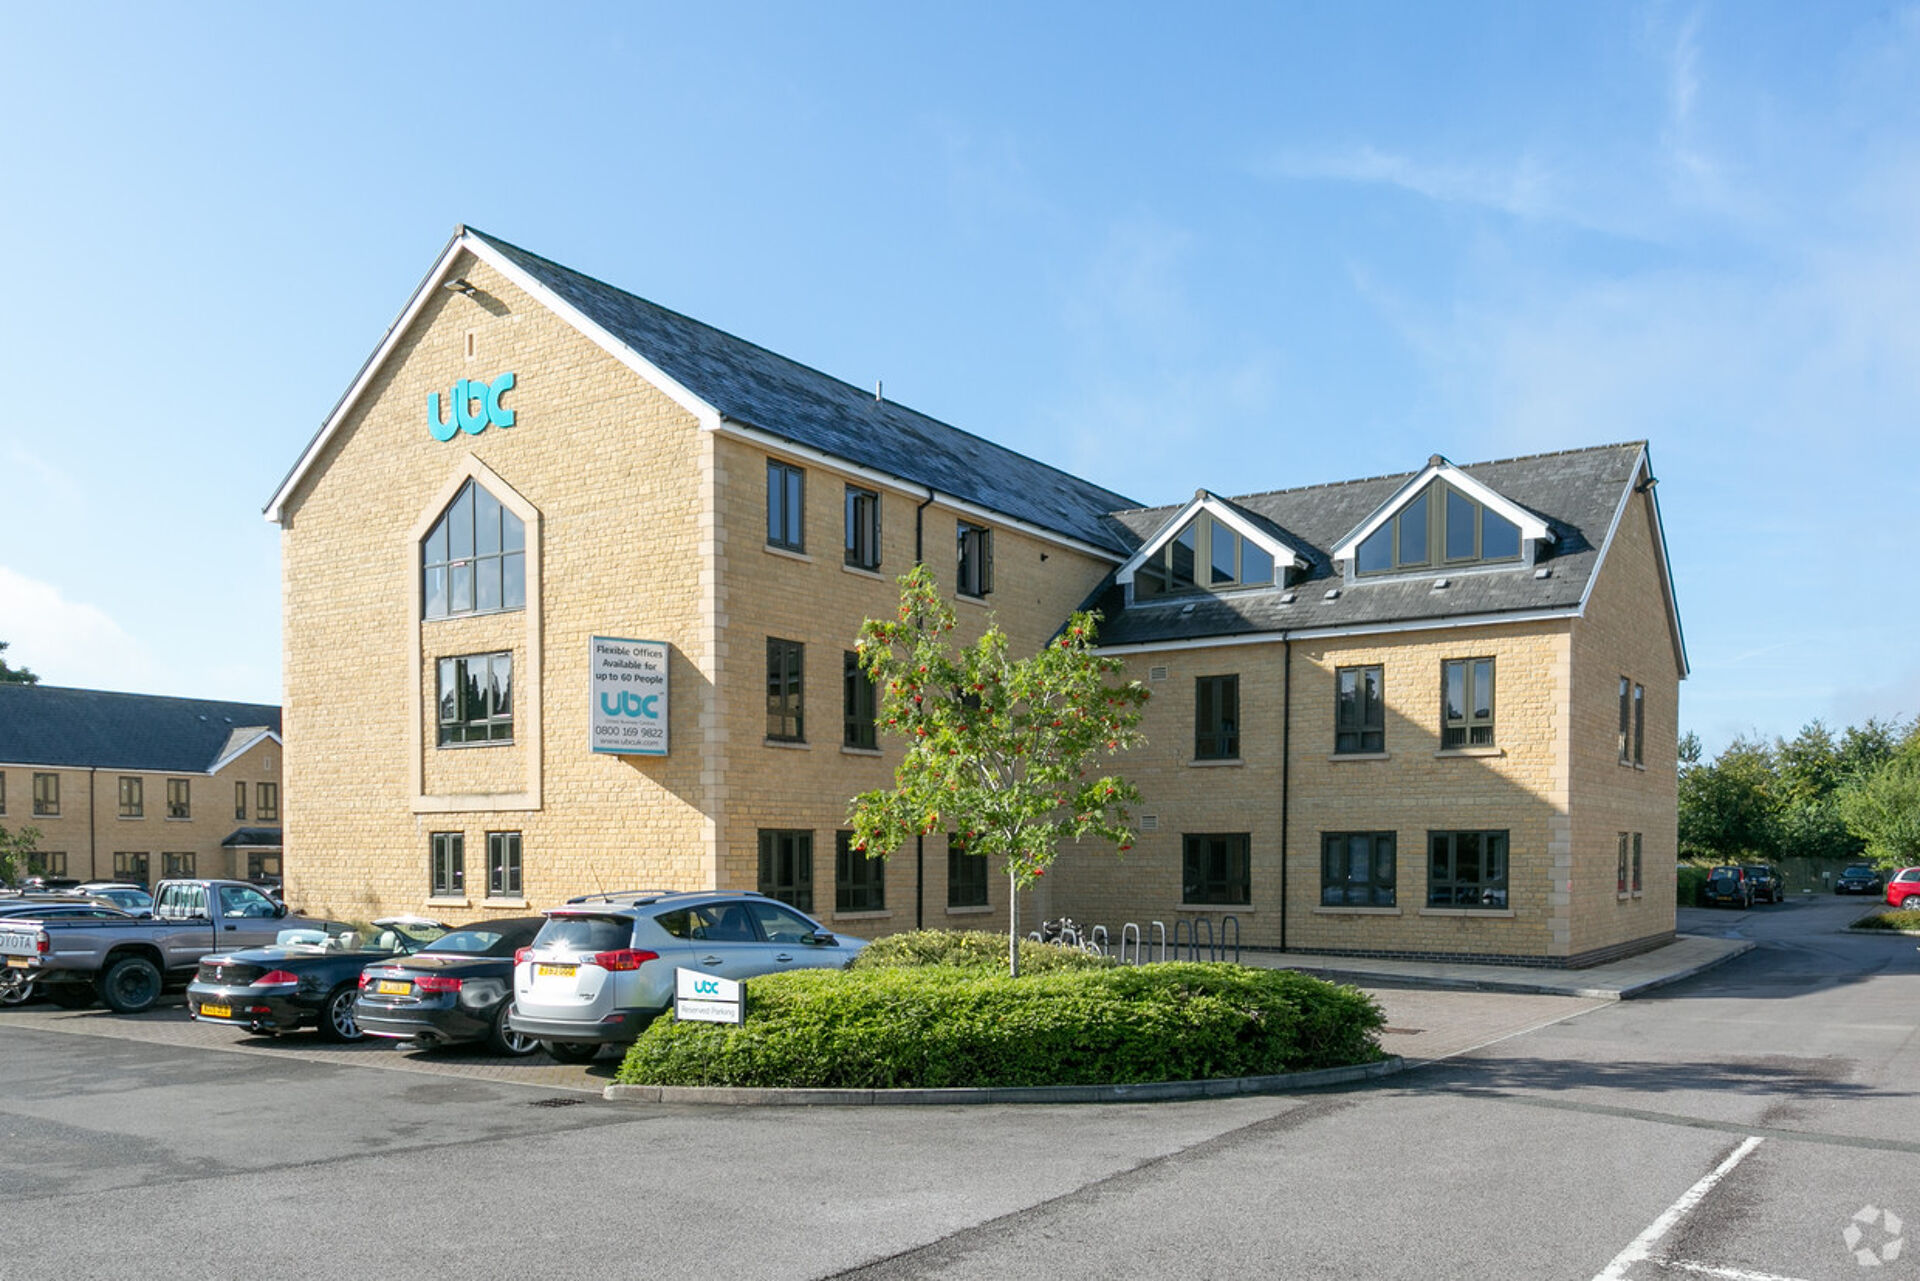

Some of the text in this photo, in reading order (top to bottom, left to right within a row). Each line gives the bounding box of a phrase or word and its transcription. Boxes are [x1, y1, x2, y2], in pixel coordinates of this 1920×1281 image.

[427, 371, 515, 442] ubc
[596, 645, 663, 659] Flexible Offices
[602, 659, 657, 671] Available for
[595, 673, 664, 686] up to 60 People
[600, 690, 659, 719] ubc
[595, 725, 620, 737] 0800
[622, 727, 639, 737] 169
[694, 979, 719, 995] ubc
[711, 1006, 735, 1018] Parking
